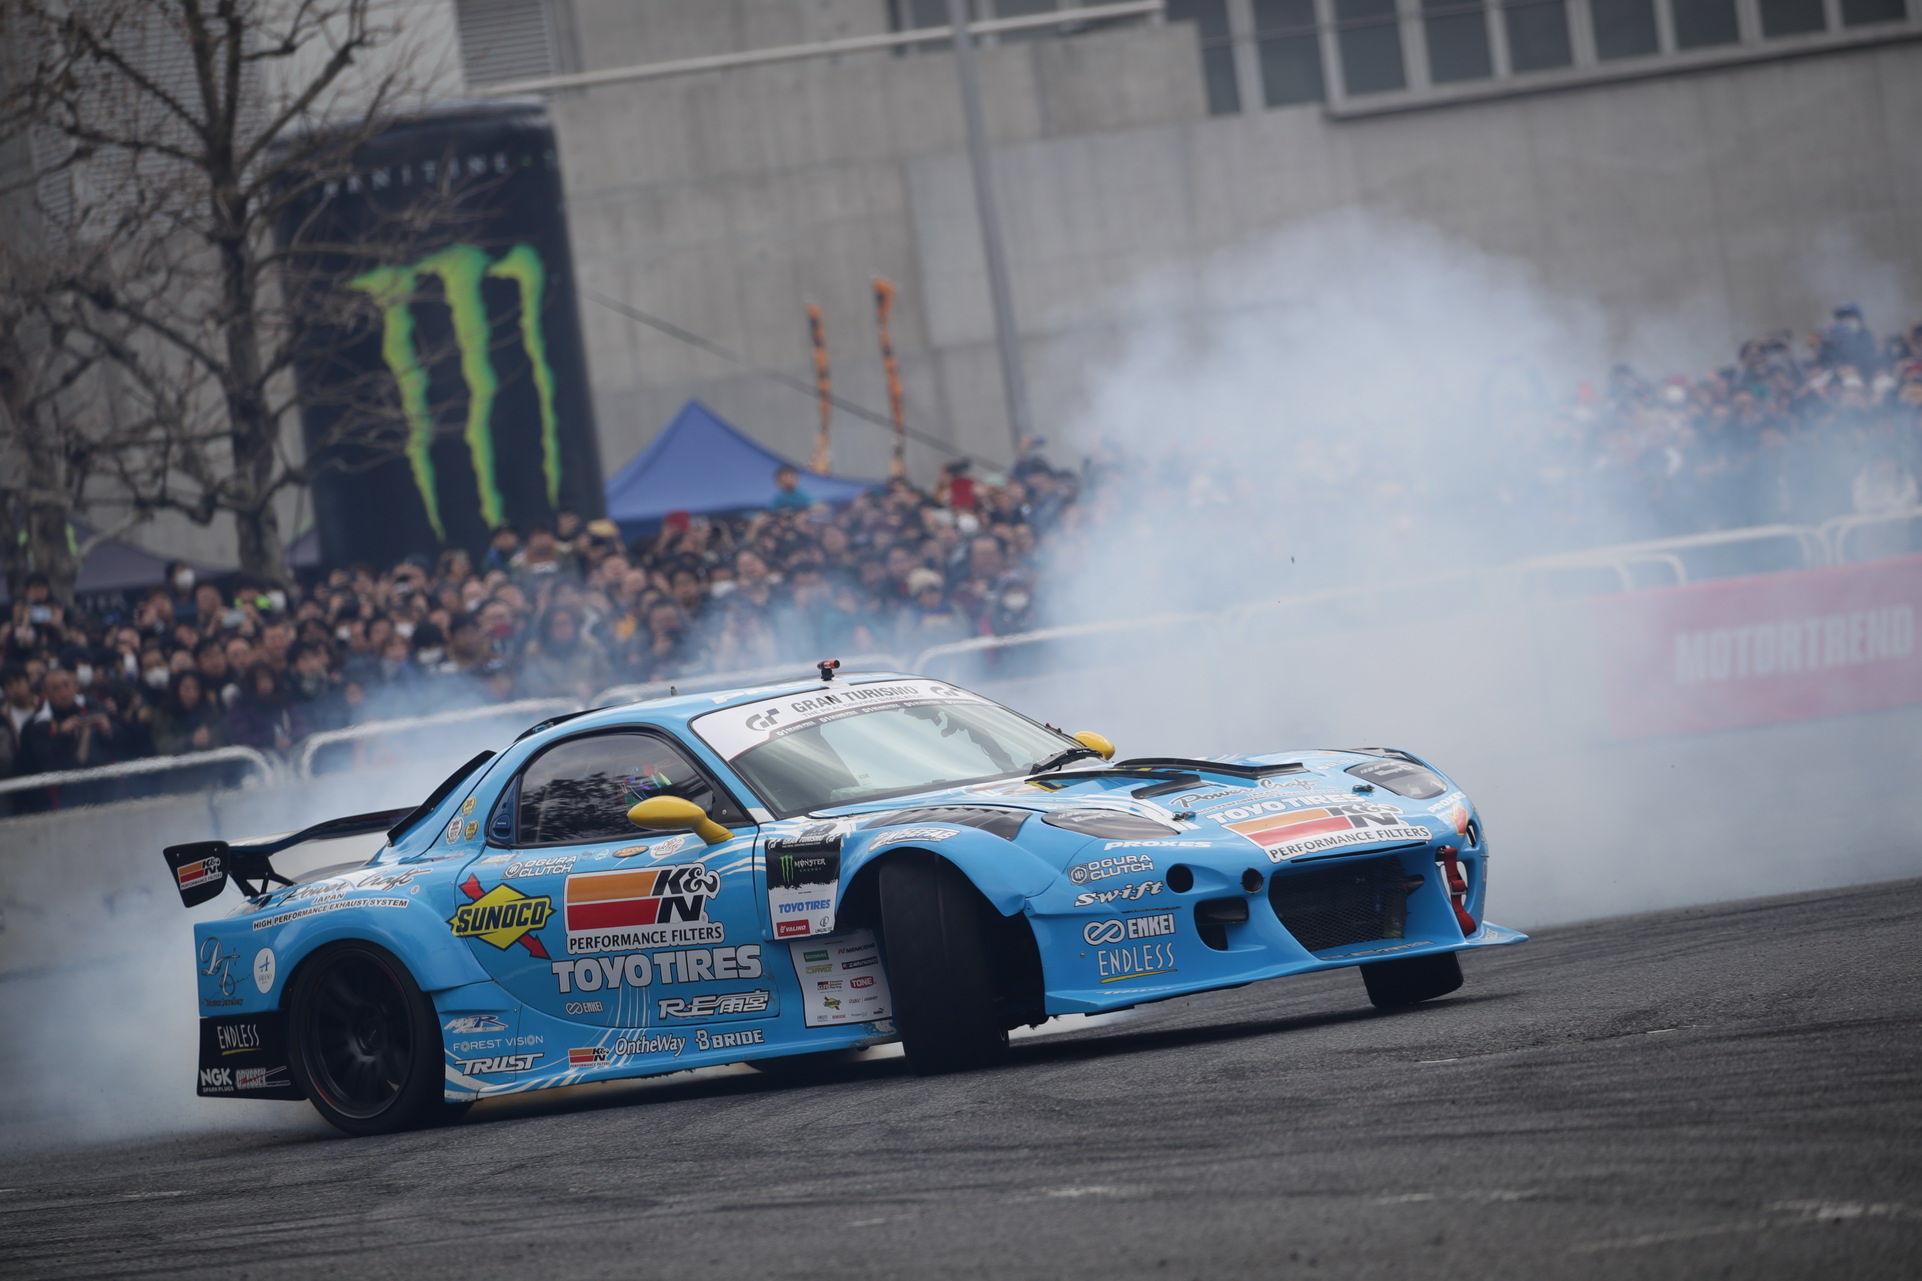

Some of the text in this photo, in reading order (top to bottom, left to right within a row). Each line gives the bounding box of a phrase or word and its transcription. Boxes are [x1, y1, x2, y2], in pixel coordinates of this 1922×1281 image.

[1675, 606, 1914, 683] MOTORTREND
[791, 693, 843, 713] GRAN
[841, 686, 919, 702] TURISMO
[803, 694, 926, 719] THE REAL DRIVING SIMULATOR
[776, 729, 788, 737] D1
[1169, 778, 1322, 809] Power Craft
[1427, 791, 1467, 812] PROXES
[1206, 794, 1366, 825] TOYO TIRES
[1104, 841, 1212, 850] PROXES
[1269, 827, 1429, 859] PERFORMANCE FILTERS
[519, 864, 574, 877] CLUTCH
[524, 856, 577, 868] OGURA
[1088, 855, 1152, 870] OGURA
[1090, 863, 1153, 880] CLUTCH
[277, 868, 432, 907] Power Craft
[313, 893, 344, 904] JAPAN
[253, 899, 408, 930] HIGH PERFORMANCE EXHAUST SYSTEM
[457, 901, 547, 932] SUNOCO
[779, 899, 831, 913] TOYO TIRES
[1127, 913, 1175, 939] ENKEI
[569, 926, 722, 951] PERFORMANCE FILTERS
[552, 944, 762, 993] TOYO TIRES
[1098, 942, 1175, 976] ENDLESS
[851, 978, 872, 987] TONE
[583, 1000, 603, 1013] ENKEI
[217, 1024, 260, 1049] ENDLESS
[453, 1034, 544, 1052] FOREST VISION
[615, 1033, 686, 1057] OntheWay
[711, 1029, 765, 1048] BRIDE
[455, 1052, 544, 1076] TRUST
[200, 1068, 232, 1086] NGK
